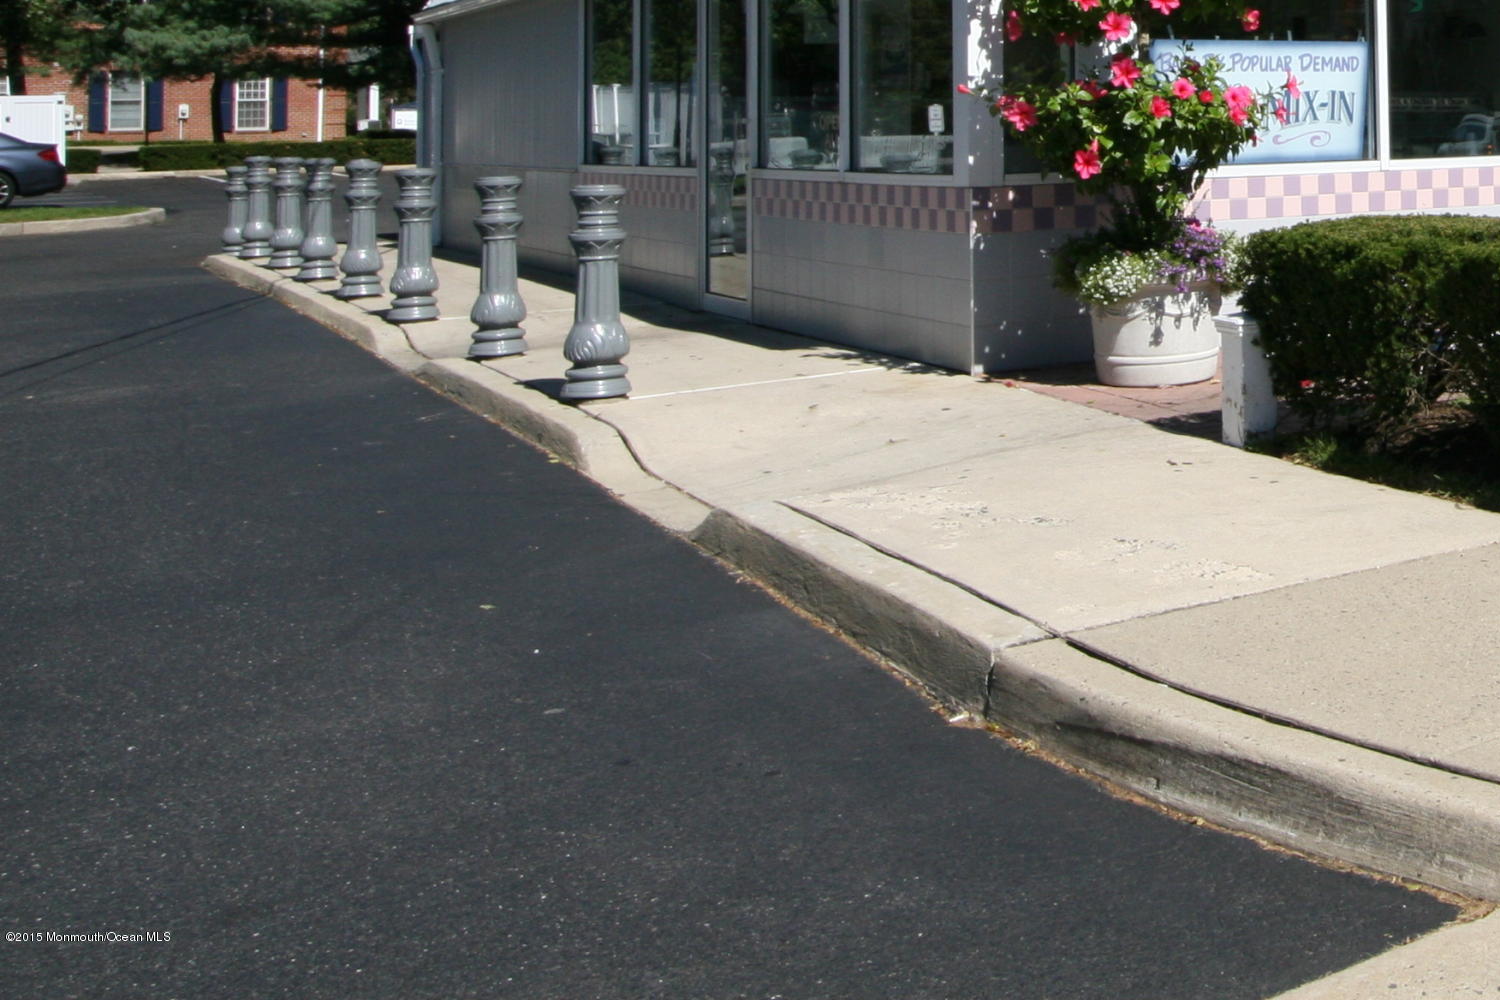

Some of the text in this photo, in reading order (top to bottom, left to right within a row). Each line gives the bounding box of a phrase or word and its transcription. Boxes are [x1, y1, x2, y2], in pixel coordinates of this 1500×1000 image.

[1229, 52, 1293, 73] POPULAR
[1298, 53, 1360, 73] DEMAND
[1263, 89, 1356, 132] MIX-IN
